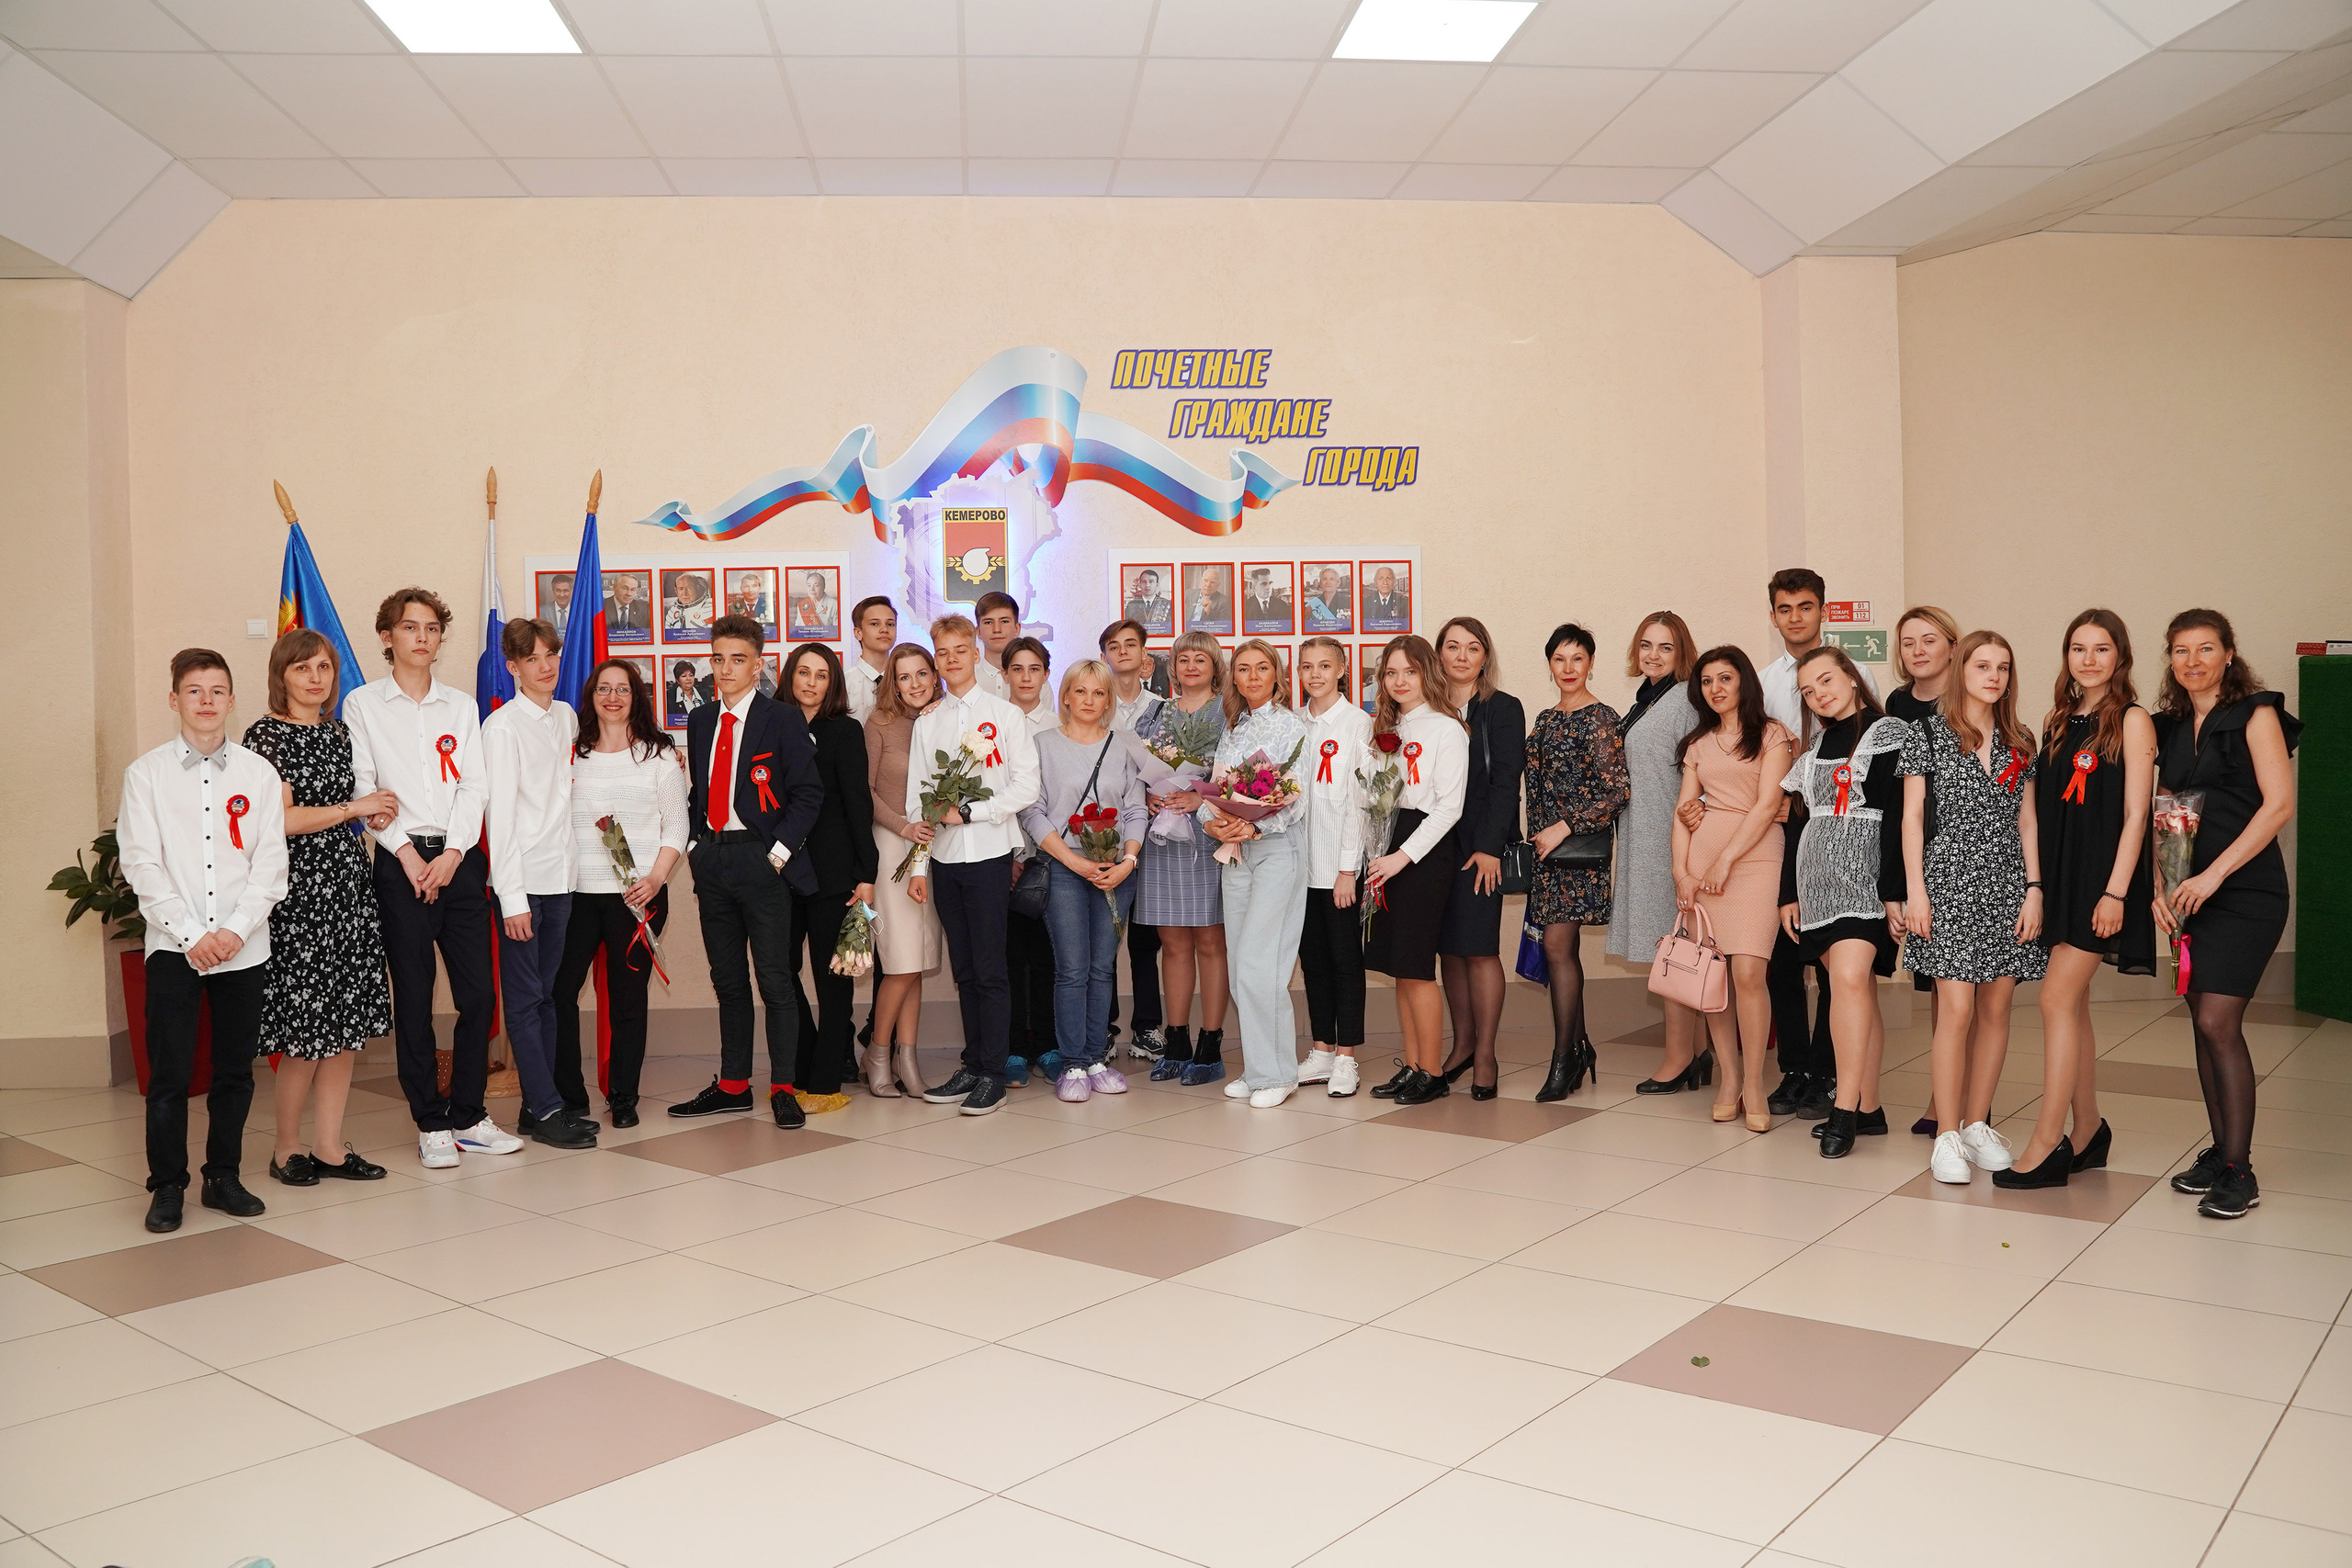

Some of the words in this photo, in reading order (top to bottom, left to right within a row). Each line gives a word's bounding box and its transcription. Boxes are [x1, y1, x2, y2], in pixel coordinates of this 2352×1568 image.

[1111, 349, 1272, 389] ПОЧЕТНЫЕ
[1169, 399, 1332, 444] ГРАЖДАНЕ
[1303, 446, 1419, 491] ГОРОДА
[944, 510, 1006, 521] КЕМЕРОВО
